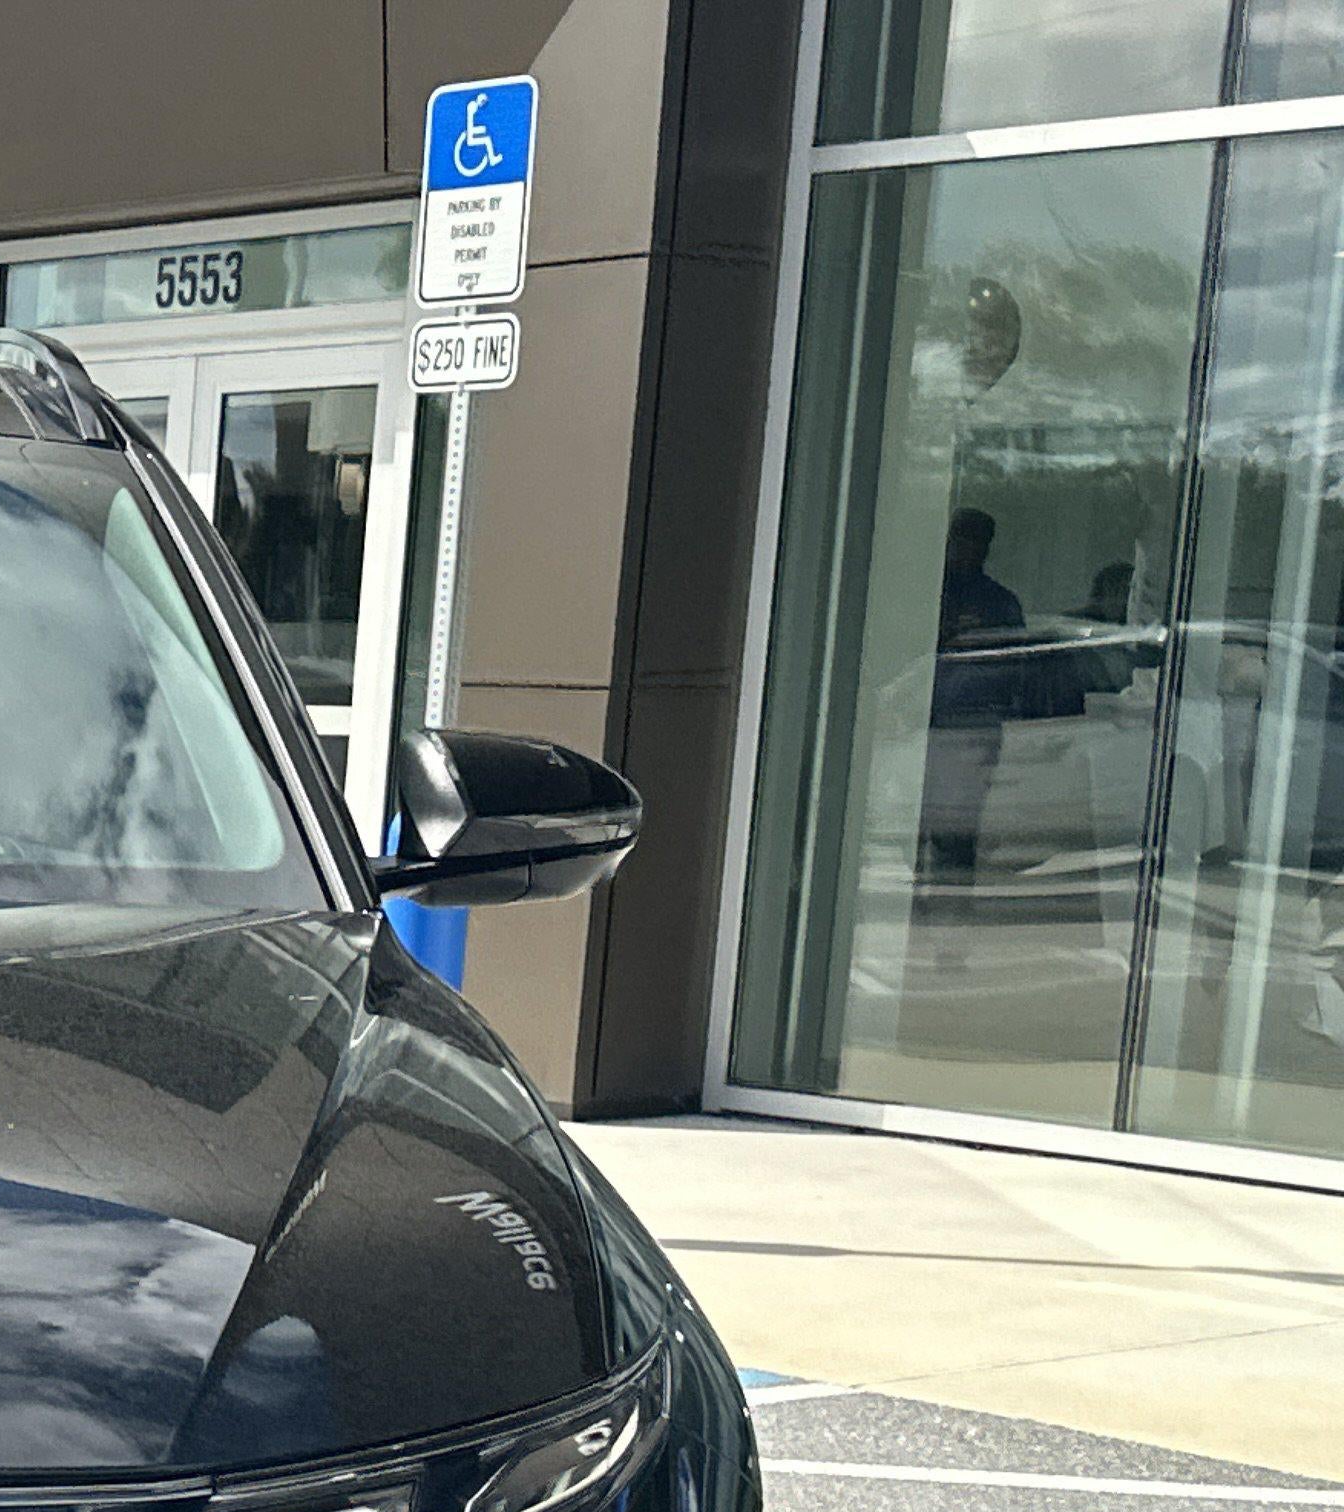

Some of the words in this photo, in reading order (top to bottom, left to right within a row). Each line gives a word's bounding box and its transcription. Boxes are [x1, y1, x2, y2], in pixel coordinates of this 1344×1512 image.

[488, 196, 502, 212] BY
[155, 250, 244, 309] 5553
[417, 337, 464, 375] $250
[472, 335, 509, 369] FINE
